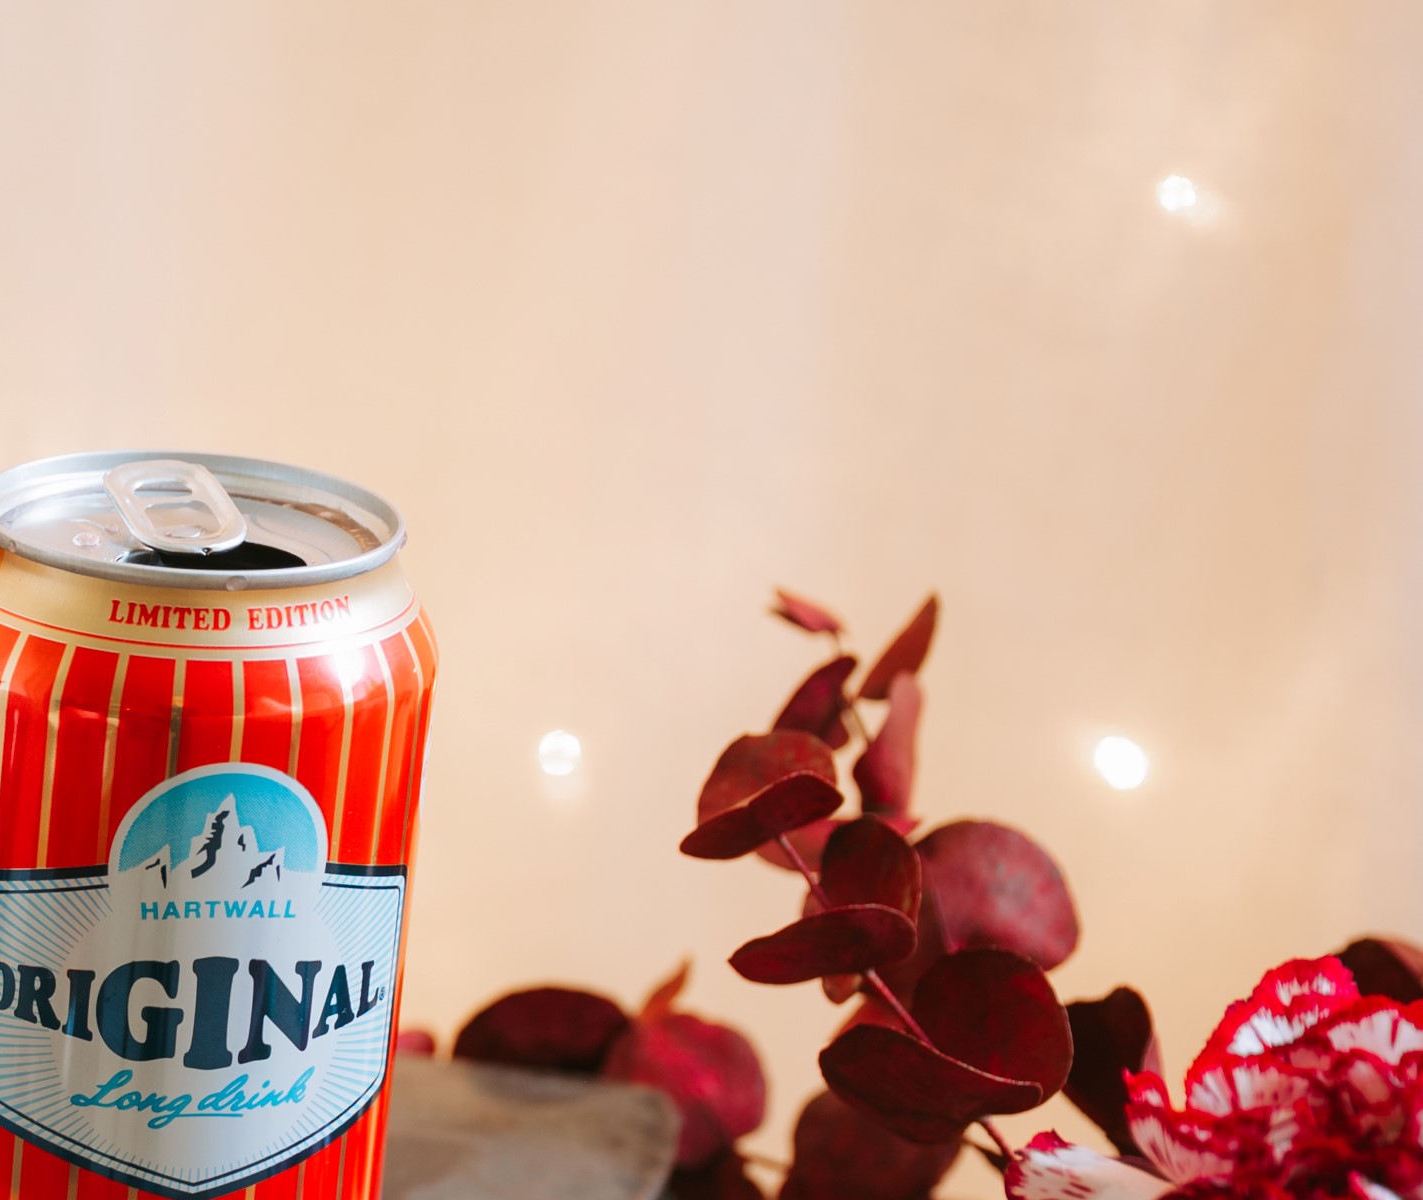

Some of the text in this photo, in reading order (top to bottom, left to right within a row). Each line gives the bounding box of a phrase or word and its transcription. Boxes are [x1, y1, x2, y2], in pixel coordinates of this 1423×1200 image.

[108, 595, 352, 631] LIMITED EDITION
[140, 899, 297, 921] HARTWALL
[70, 1065, 315, 1129] Long drink
